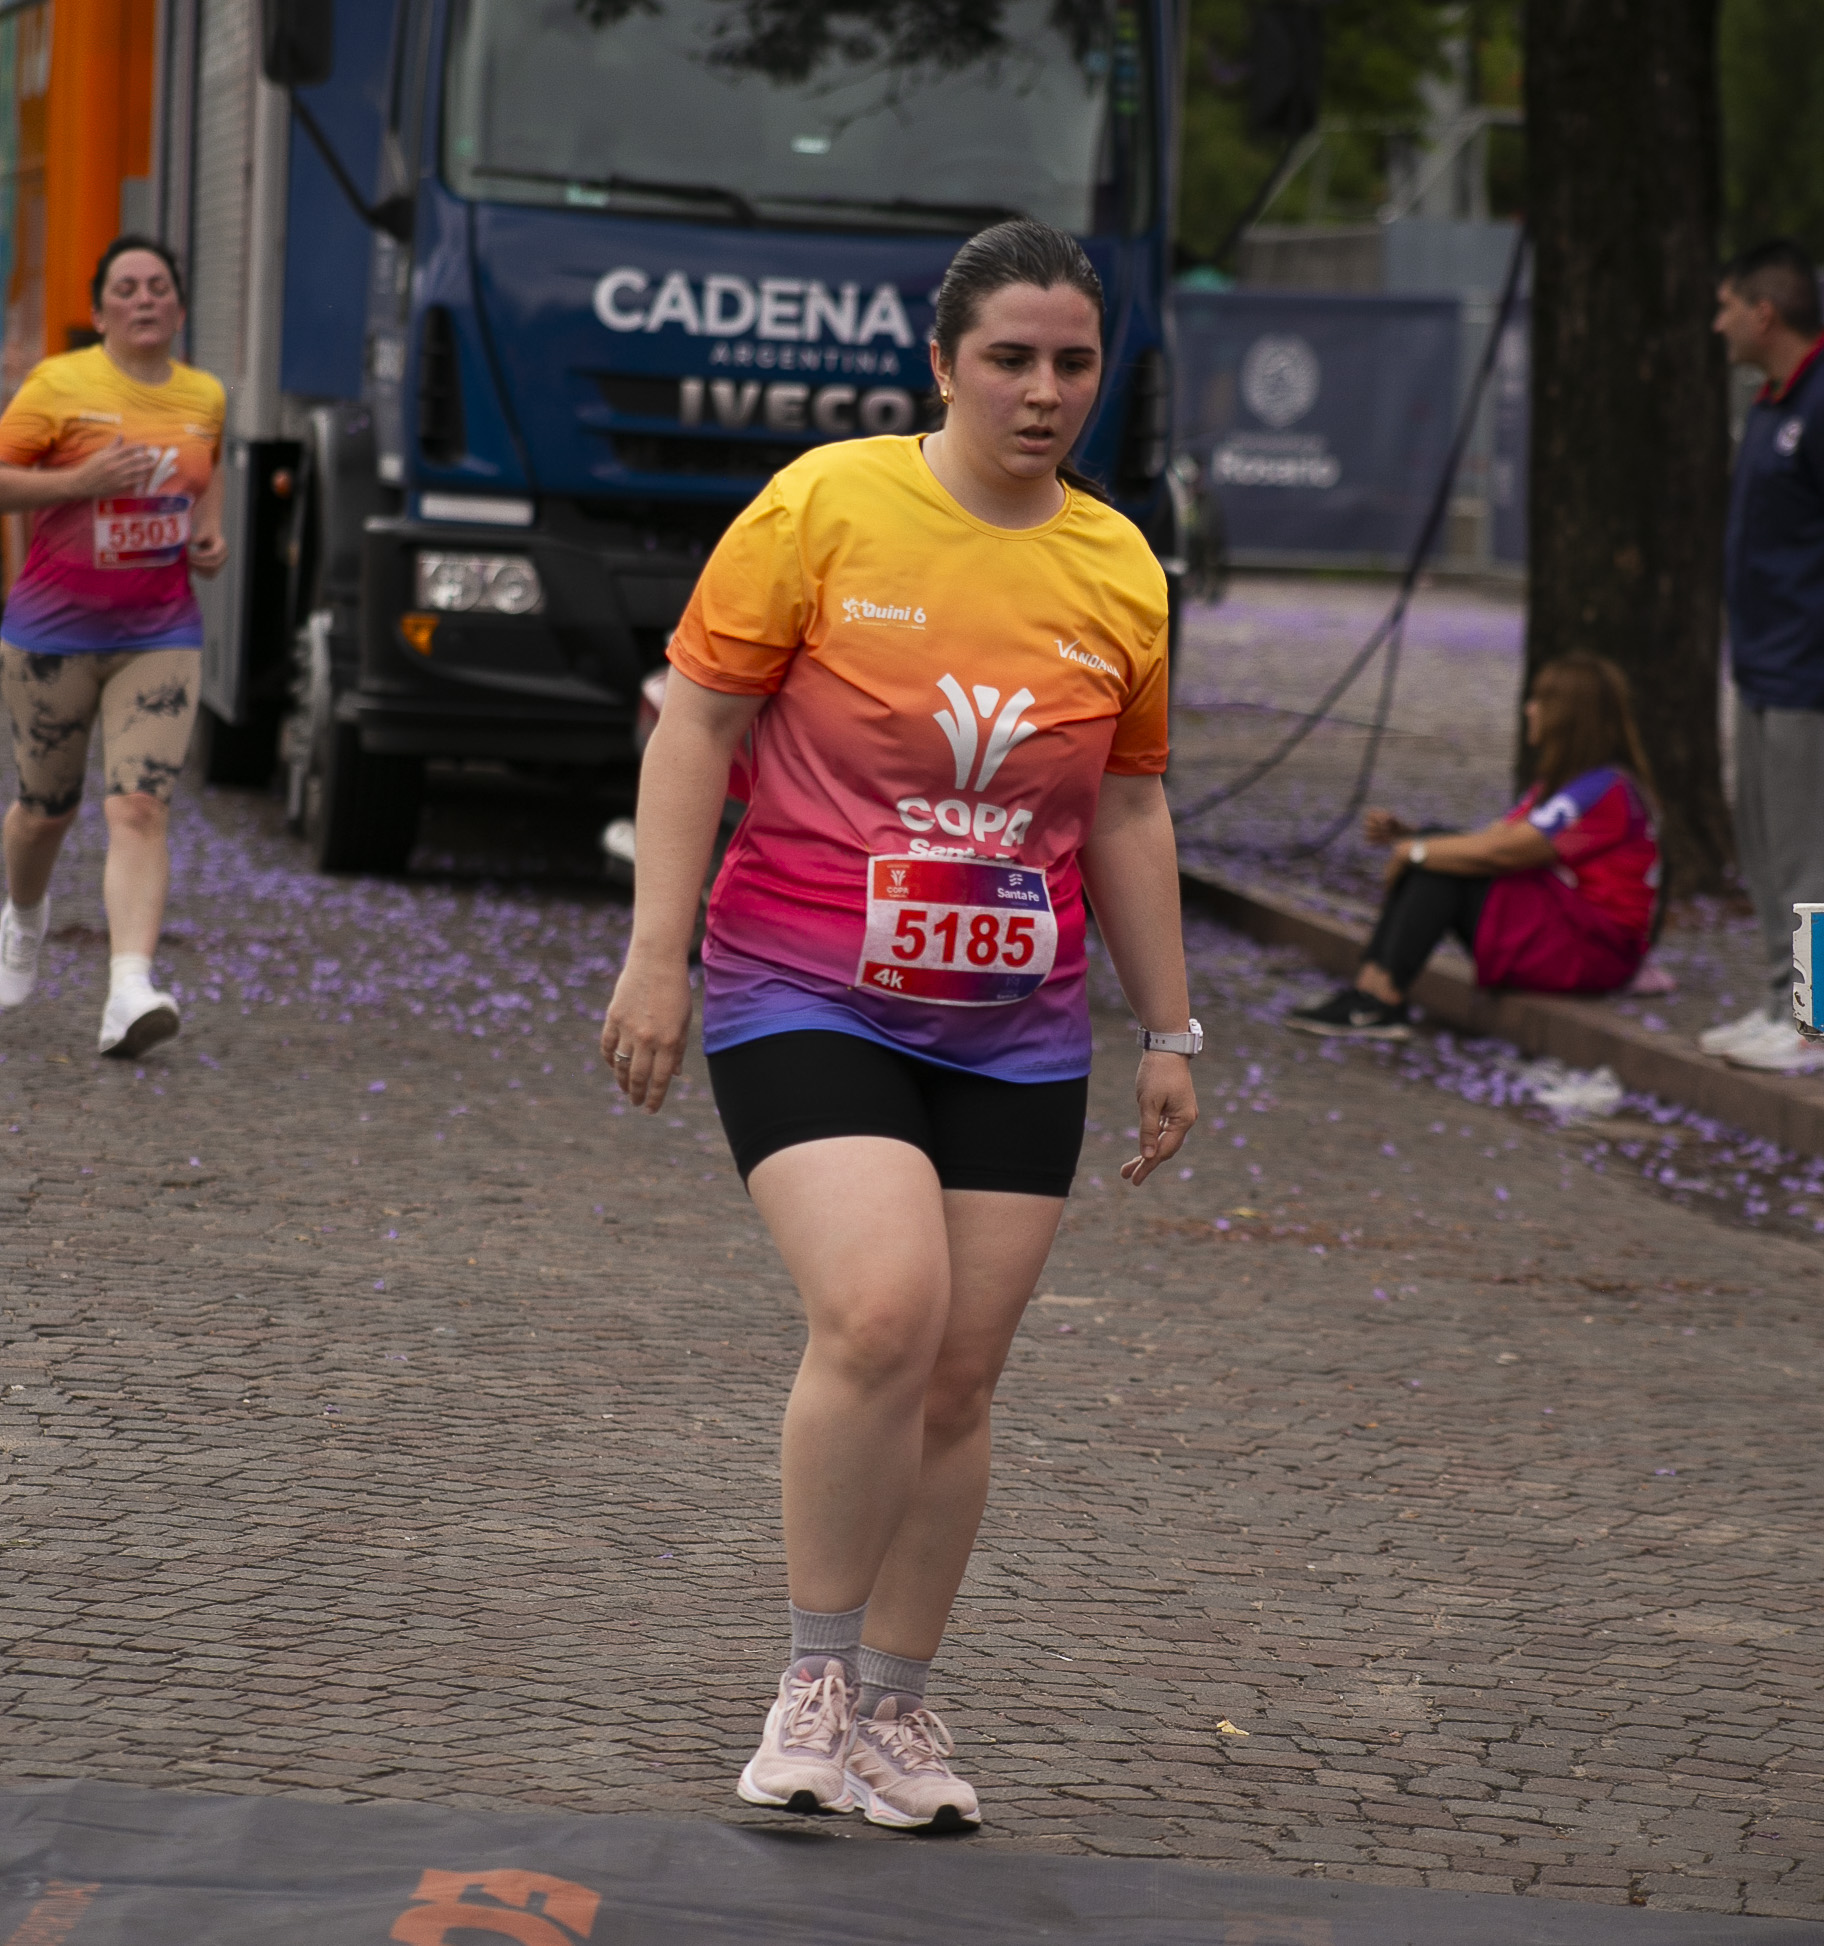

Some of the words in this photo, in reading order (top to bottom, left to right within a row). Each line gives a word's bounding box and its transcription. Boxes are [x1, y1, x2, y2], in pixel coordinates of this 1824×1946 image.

[593, 266, 914, 348] CADENA
[709, 341, 900, 375] ARGENTINA
[679, 377, 915, 433] IVECO
[913, 607, 927, 624] 6
[897, 797, 1033, 847] COPA
[997, 887, 1027, 901] Santa
[1027, 891, 1040, 902] Fe
[891, 909, 1035, 968] 5185
[873, 969, 905, 989] 4k
